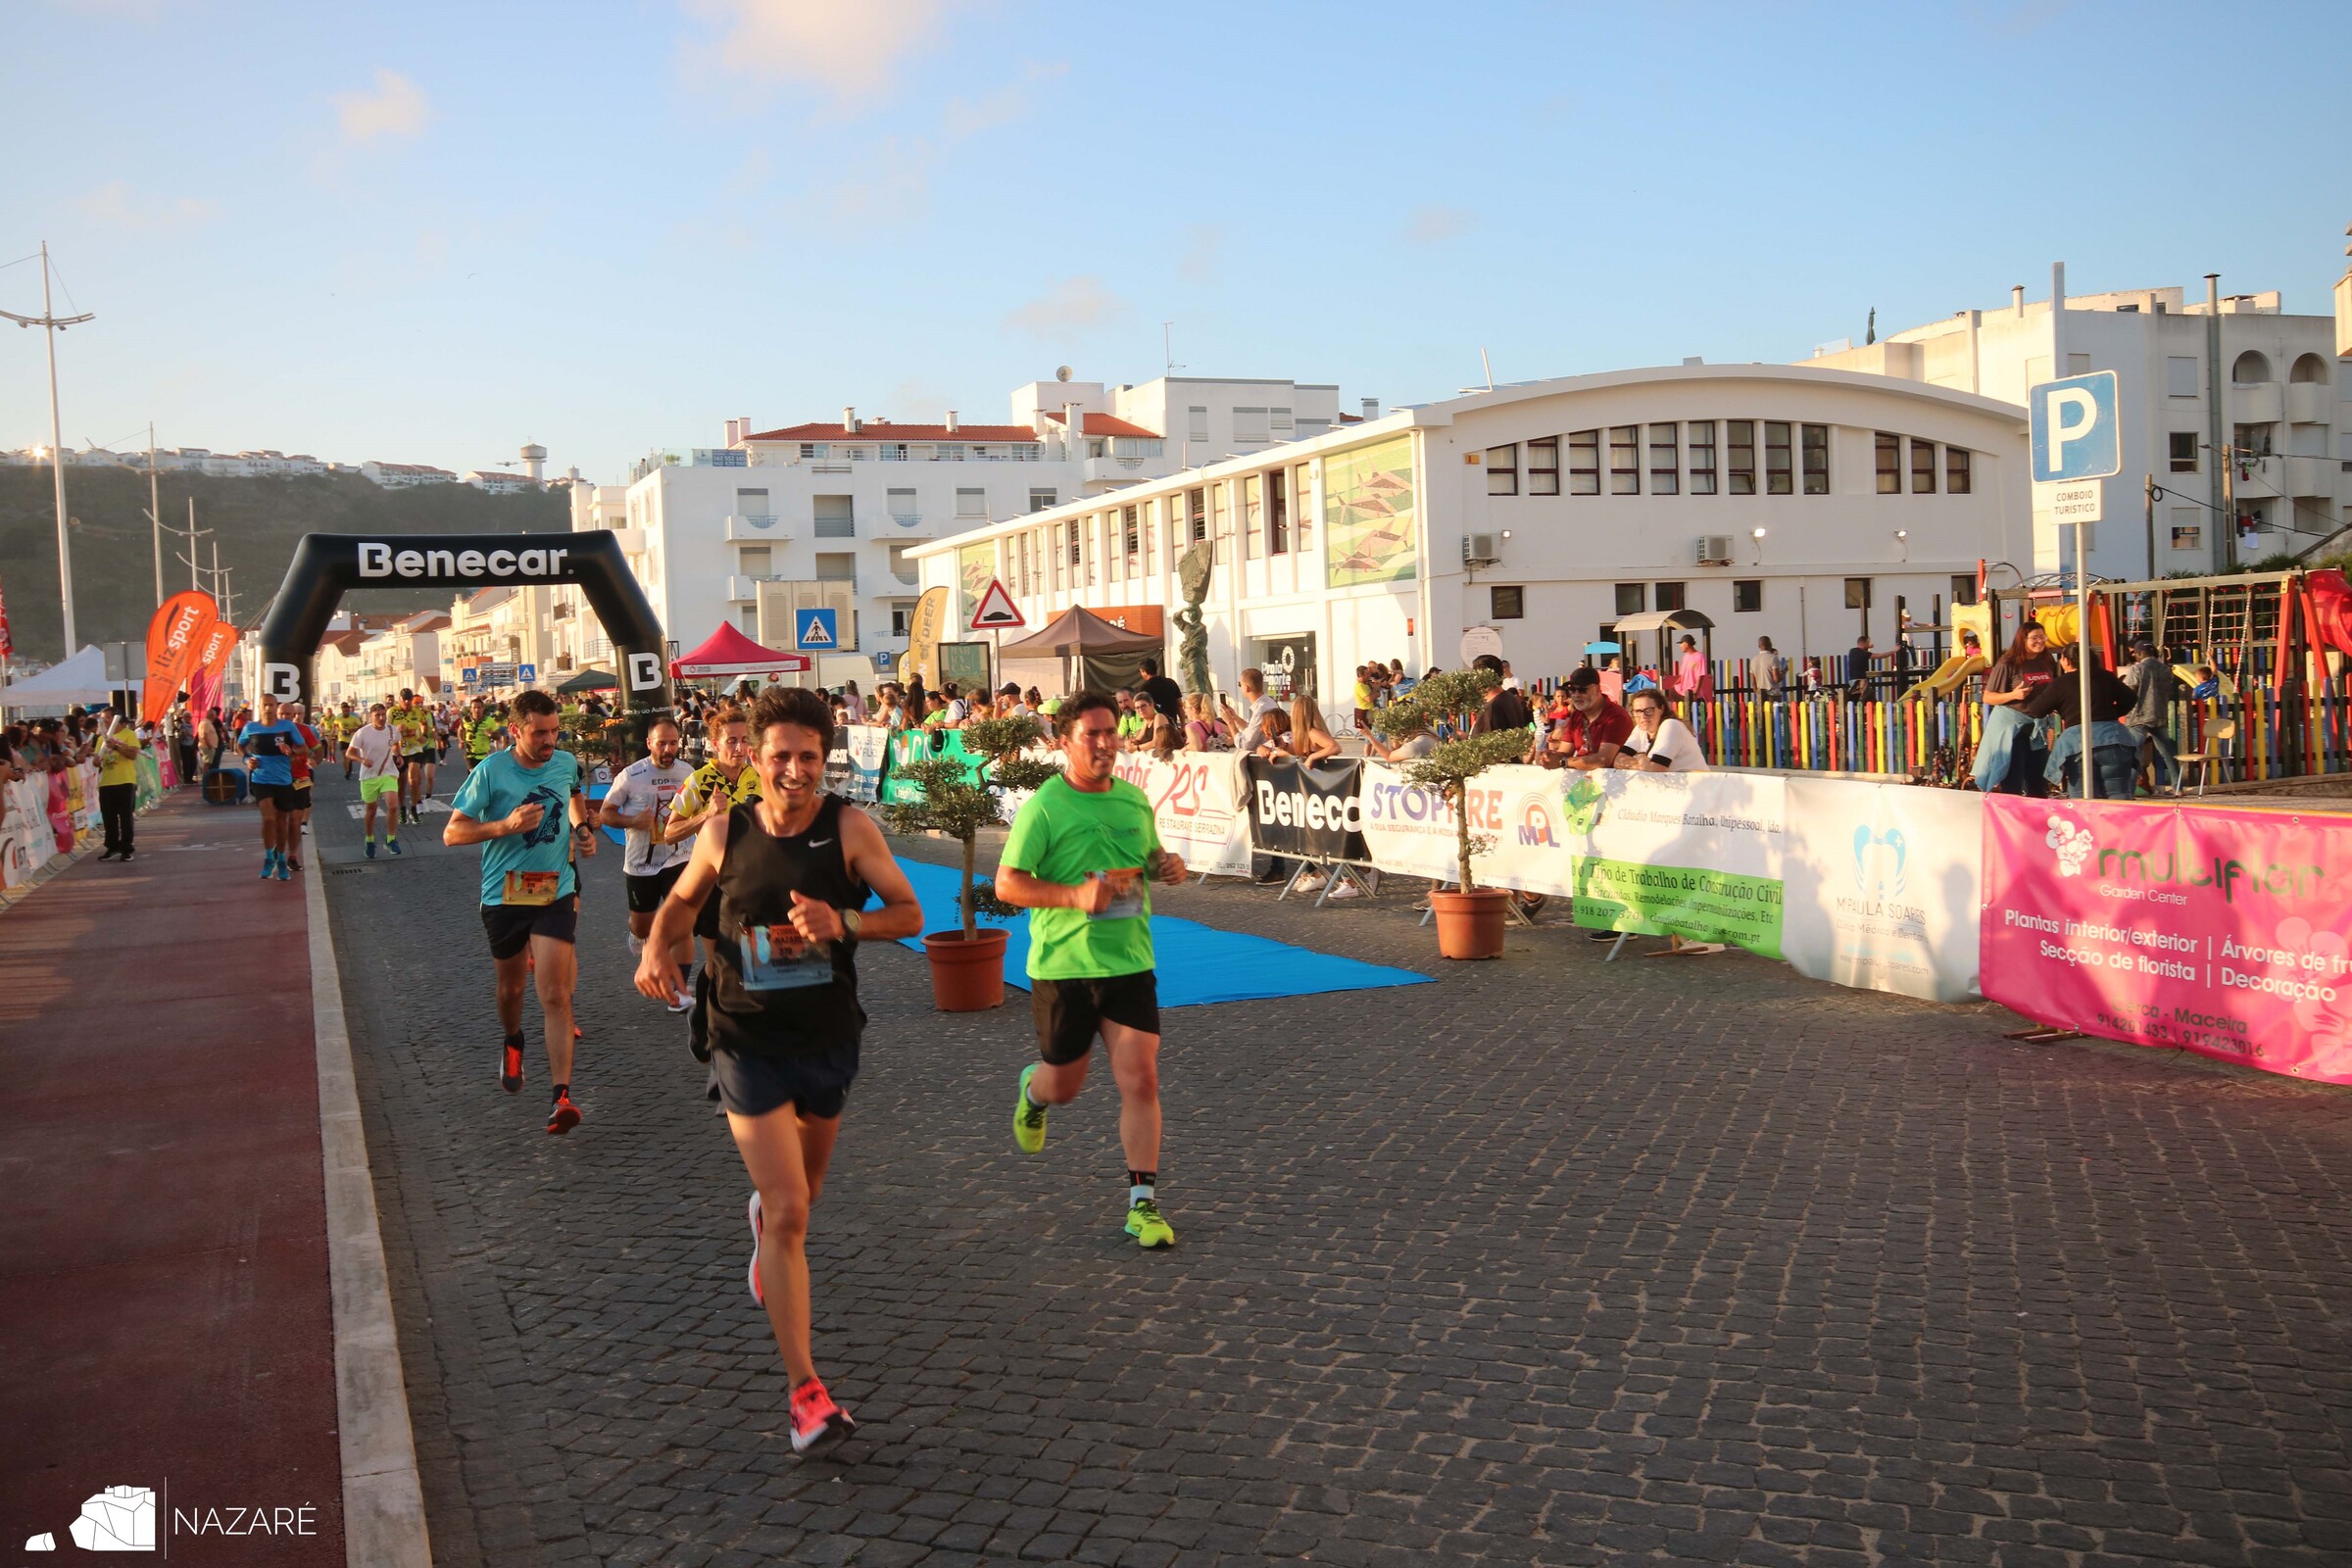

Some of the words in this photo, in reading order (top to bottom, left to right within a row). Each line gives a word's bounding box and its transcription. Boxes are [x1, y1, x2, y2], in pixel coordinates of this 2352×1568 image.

[2047, 387, 2097, 472] P
[2054, 503, 2095, 515] TURÍSTICO
[2056, 490, 2093, 502] COMBOIO
[628, 653, 664, 691] B
[1618, 808, 1647, 822] Cláudio
[1650, 810, 1681, 829] Marques
[1590, 862, 1612, 886] Tipo
[1615, 866, 1627, 883] de
[1630, 868, 1679, 889] Trabalho
[1682, 872, 1695, 891] de
[1699, 876, 1752, 903] Construção
[1757, 884, 1783, 906] Civil
[2099, 883, 2146, 902] Garden
[2148, 889, 2188, 906] Center
[1596, 907, 1615, 918] 207
[1888, 903, 1927, 926] SOARES
[2004, 908, 2059, 935] Plantas
[2065, 917, 2198, 954] interior/exterior
[2222, 934, 2295, 967] Árvores
[2300, 952, 2328, 972] de
[2040, 940, 2104, 967] Secção
[2109, 948, 2133, 971] de
[2137, 955, 2196, 982] florista
[2222, 968, 2337, 1004] Decoração
[2111, 997, 2161, 1019] Cerca
[2174, 1006, 2248, 1035] Maceira
